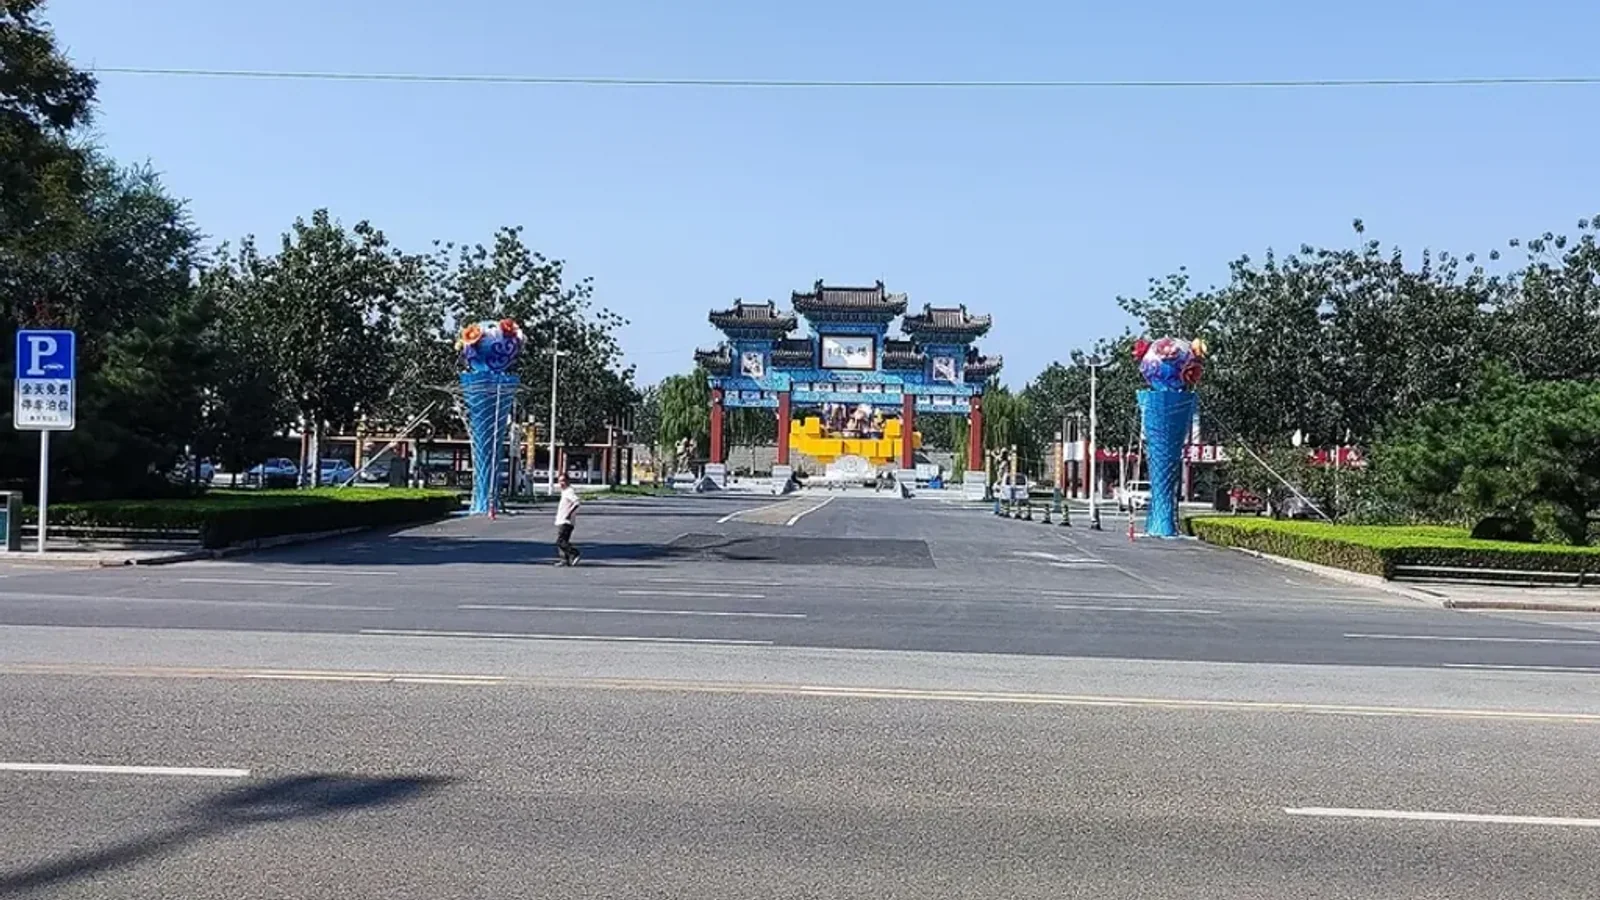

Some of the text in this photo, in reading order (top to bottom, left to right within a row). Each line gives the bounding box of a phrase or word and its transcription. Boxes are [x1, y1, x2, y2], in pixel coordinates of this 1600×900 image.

[26, 335, 58, 376] P
[22, 383, 69, 395] 全天免费
[21, 399, 69, 411] 停车泊位
